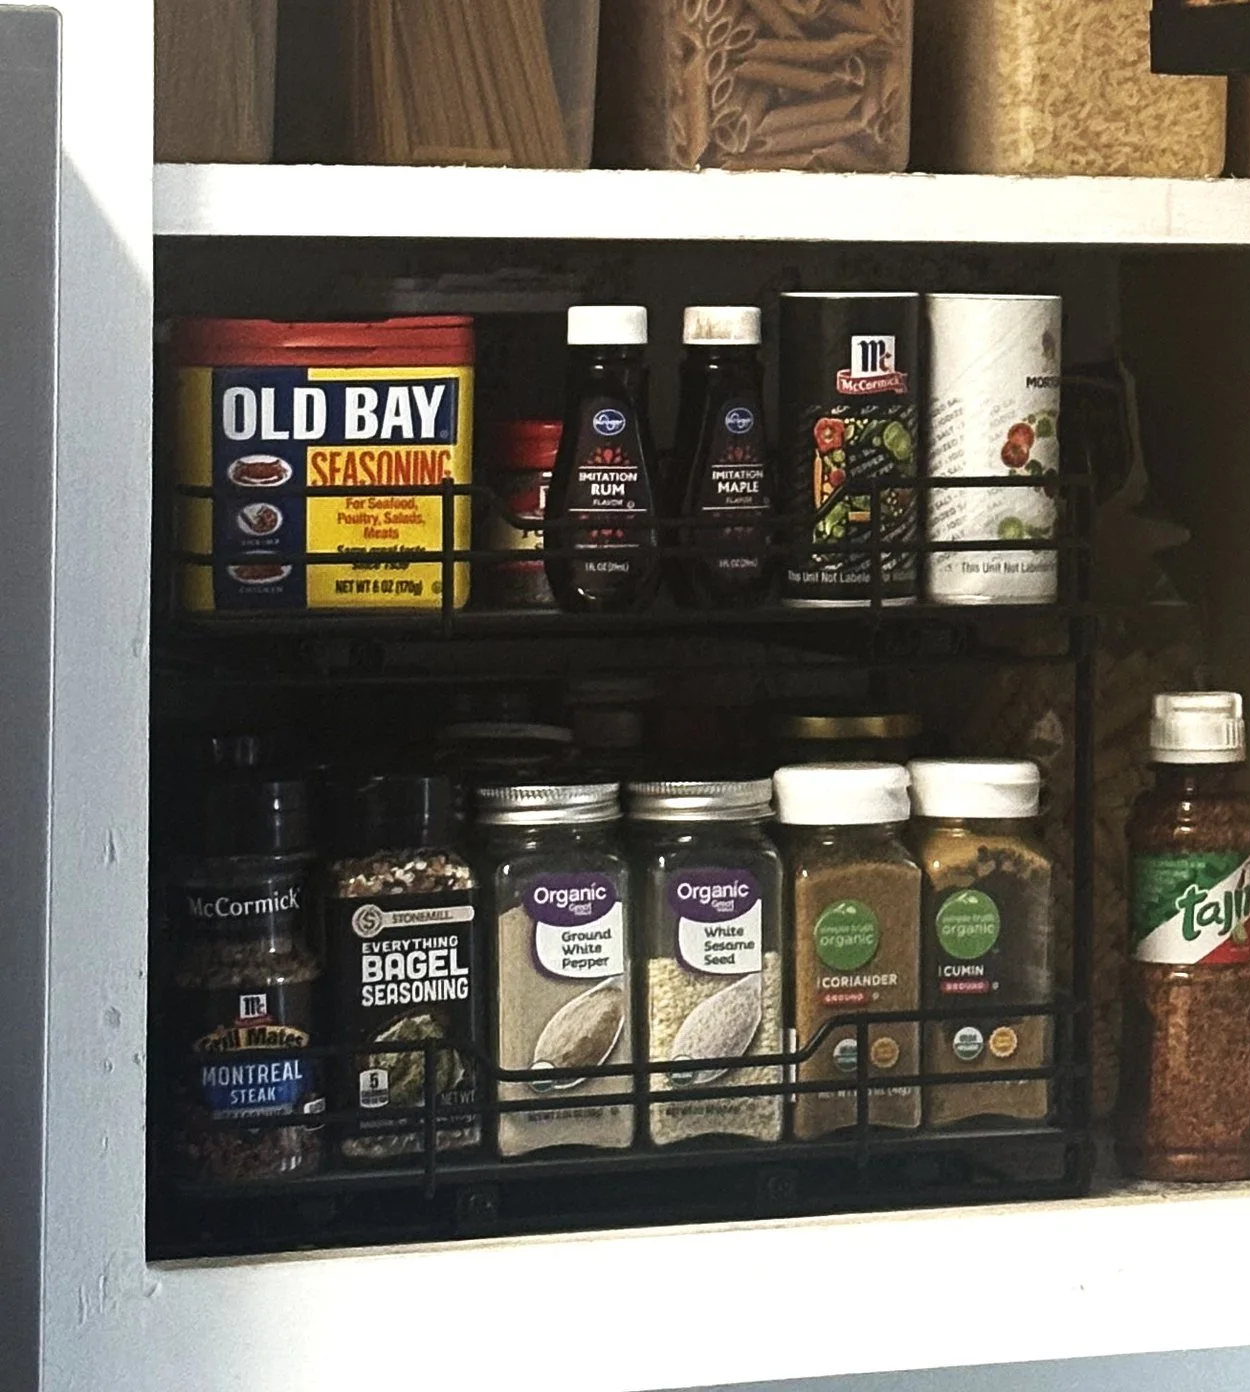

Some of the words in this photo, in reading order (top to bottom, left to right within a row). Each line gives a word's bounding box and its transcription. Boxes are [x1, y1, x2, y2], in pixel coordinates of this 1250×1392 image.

[222, 386, 328, 441] OLD
[344, 384, 447, 440] BAY
[579, 471, 638, 482] IMITATION
[712, 469, 764, 481] IMITATION
[591, 483, 625, 496] RUM
[717, 481, 759, 494] MAPLE
[345, 497, 365, 509] For
[368, 497, 418, 510] Seafood,
[337, 512, 382, 526] Poultry,
[363, 527, 400, 539] Meats
[962, 562, 980, 574] This
[982, 562, 1001, 574] Unit
[1004, 562, 1019, 574] Not
[821, 571, 838, 584] Not
[840, 571, 871, 584] Labele
[335, 580, 354, 593] NET
[356, 580, 371, 593] WT
[381, 580, 394, 593] OZ
[534, 882, 607, 908] Organic
[677, 879, 750, 905] Organic
[187, 887, 300, 918] McCormick
[561, 928, 612, 942] Ground
[704, 926, 744, 938] White
[942, 923, 995, 938] organic
[362, 935, 459, 954] EVERYTHING
[704, 940, 755, 952] Sesame
[820, 934, 874, 947] organic
[561, 943, 602, 956] White
[362, 948, 469, 983] BAGEL
[562, 956, 610, 970] Pepper
[704, 953, 736, 966] Seed
[943, 964, 985, 977] CUMIN
[822, 973, 898, 989] CORIANDER
[361, 977, 469, 1007] SEASONING
[202, 1059, 303, 1087] MONTREAL
[370, 1072, 379, 1089] 5
[230, 1087, 277, 1106] STEAK
